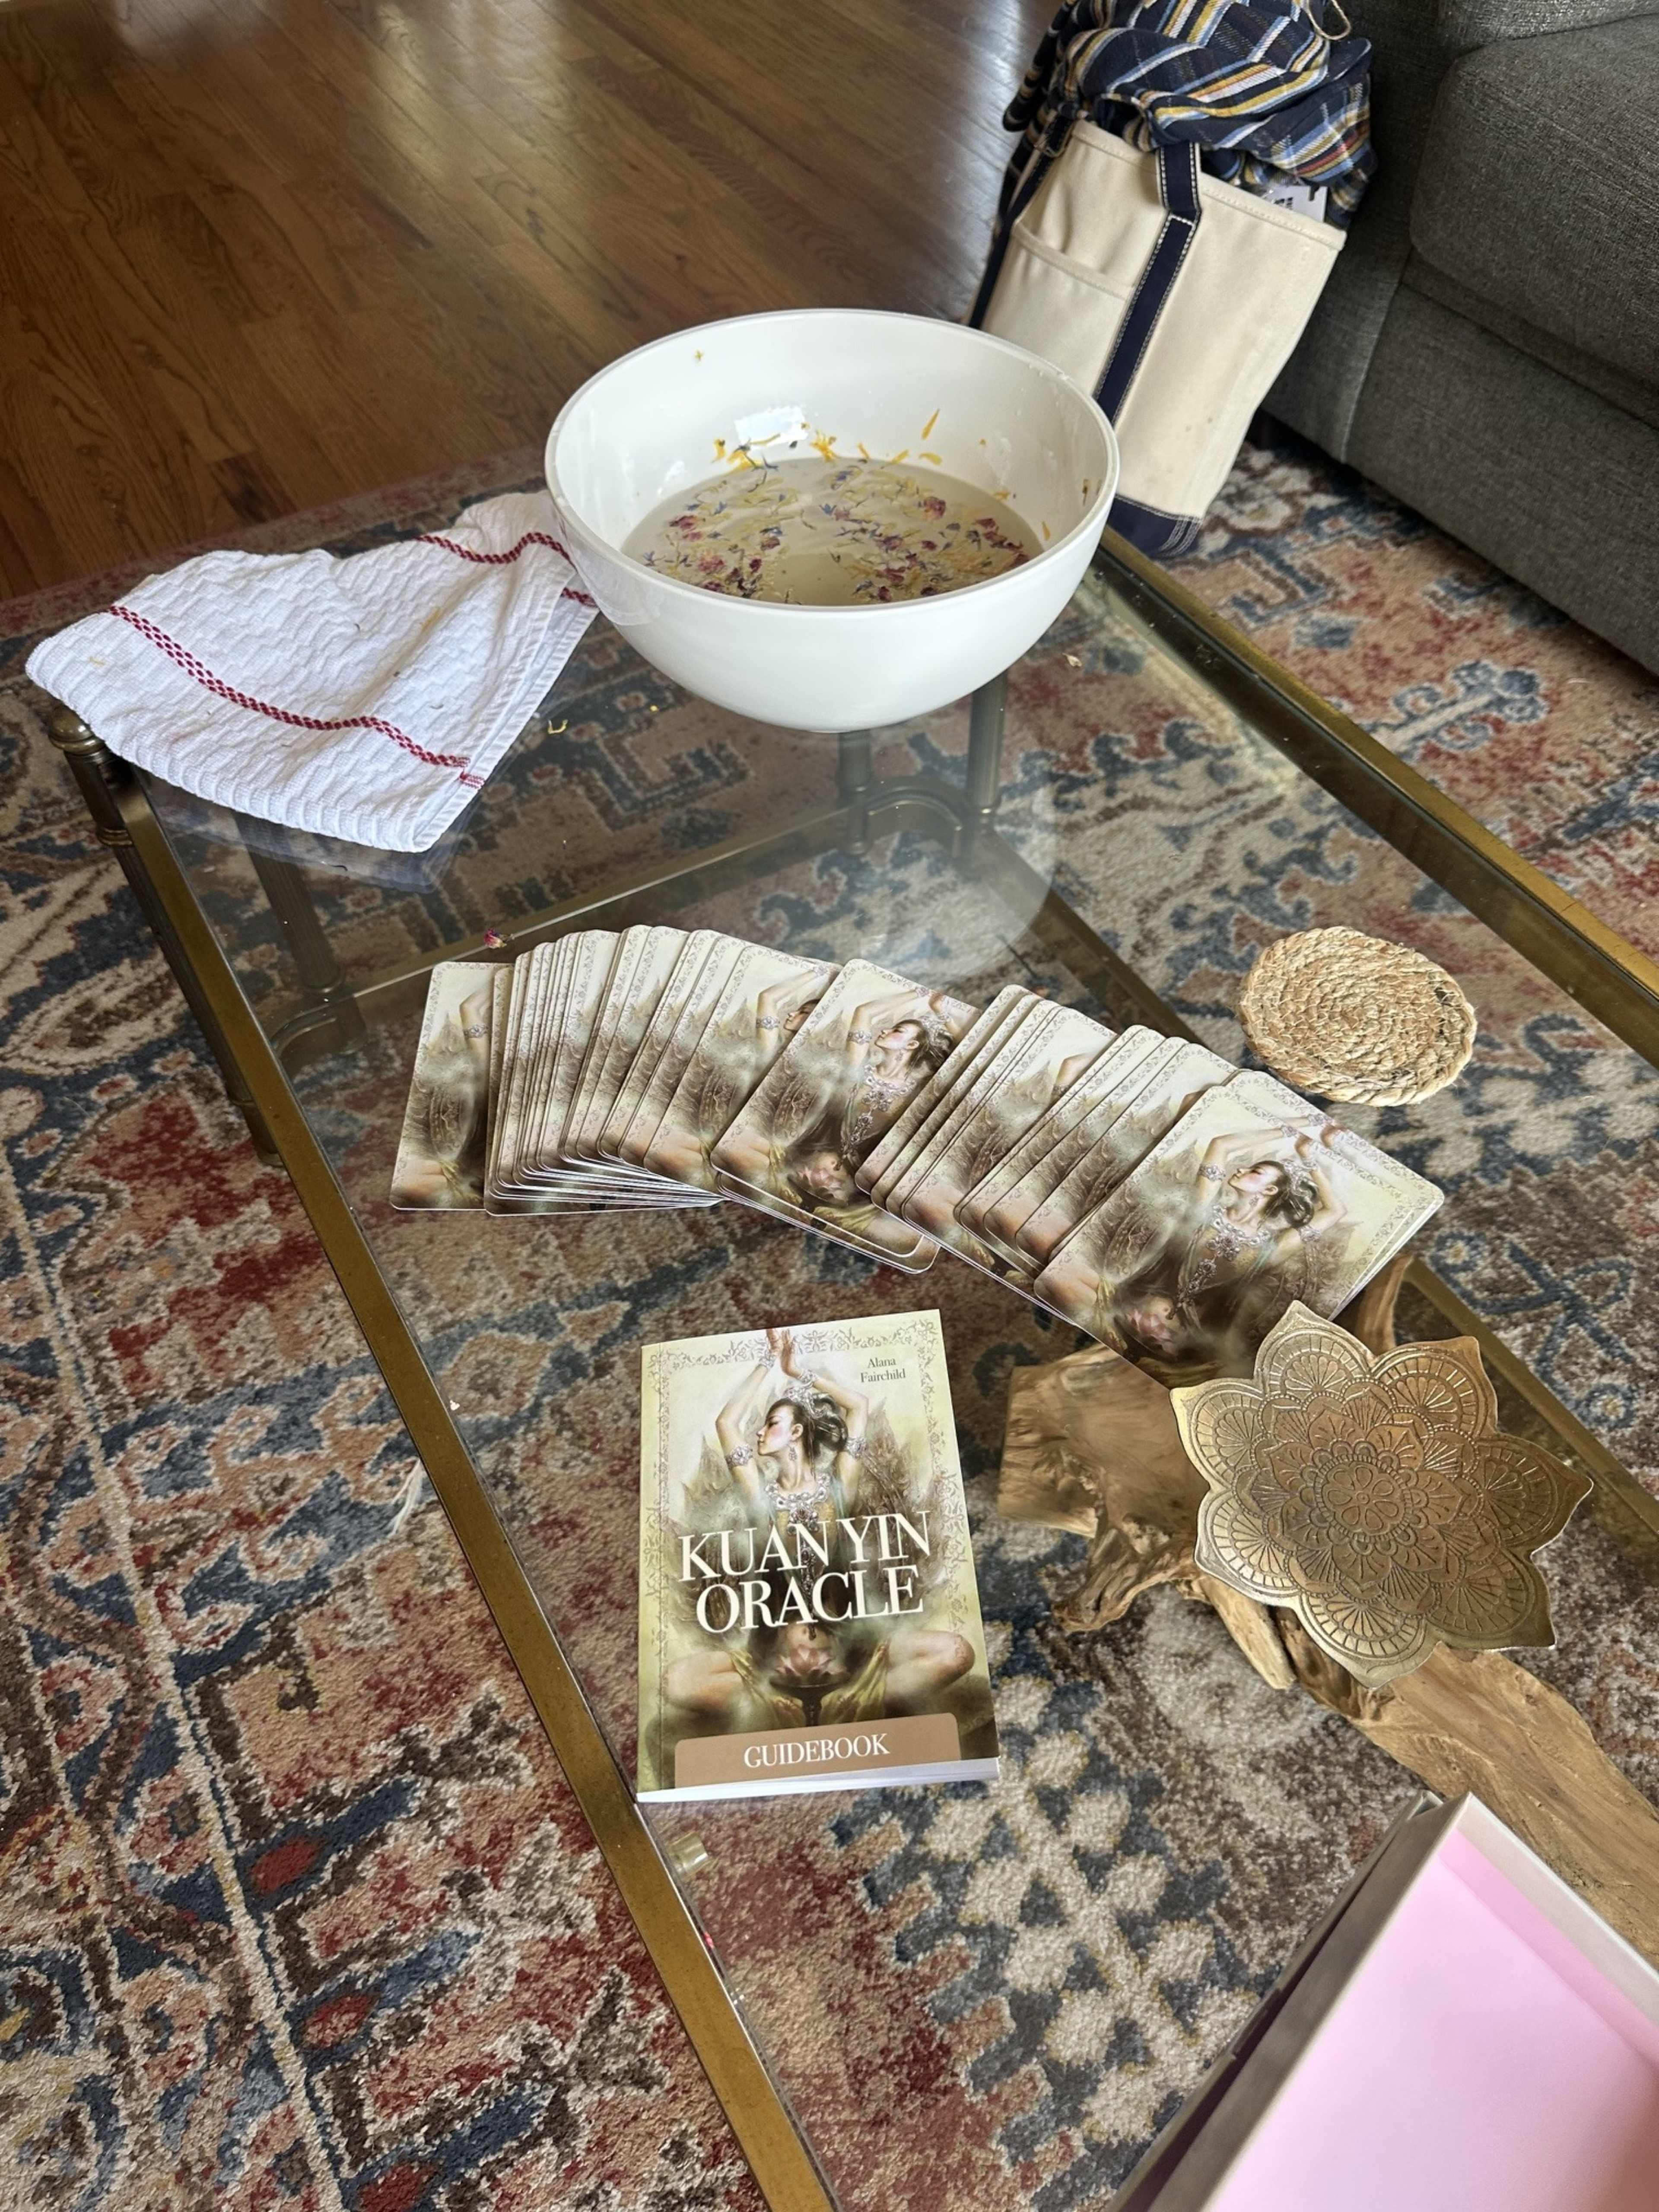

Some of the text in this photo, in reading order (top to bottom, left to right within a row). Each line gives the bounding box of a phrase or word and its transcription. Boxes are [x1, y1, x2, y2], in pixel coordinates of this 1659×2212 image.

[861, 1369, 906, 1382] Fairchild
[868, 1357, 896, 1368] Alana
[678, 1511, 930, 1583] KUAN YIN
[696, 1565, 924, 1633] ORACLE
[744, 1733, 890, 1768] GUIDEBOOK
